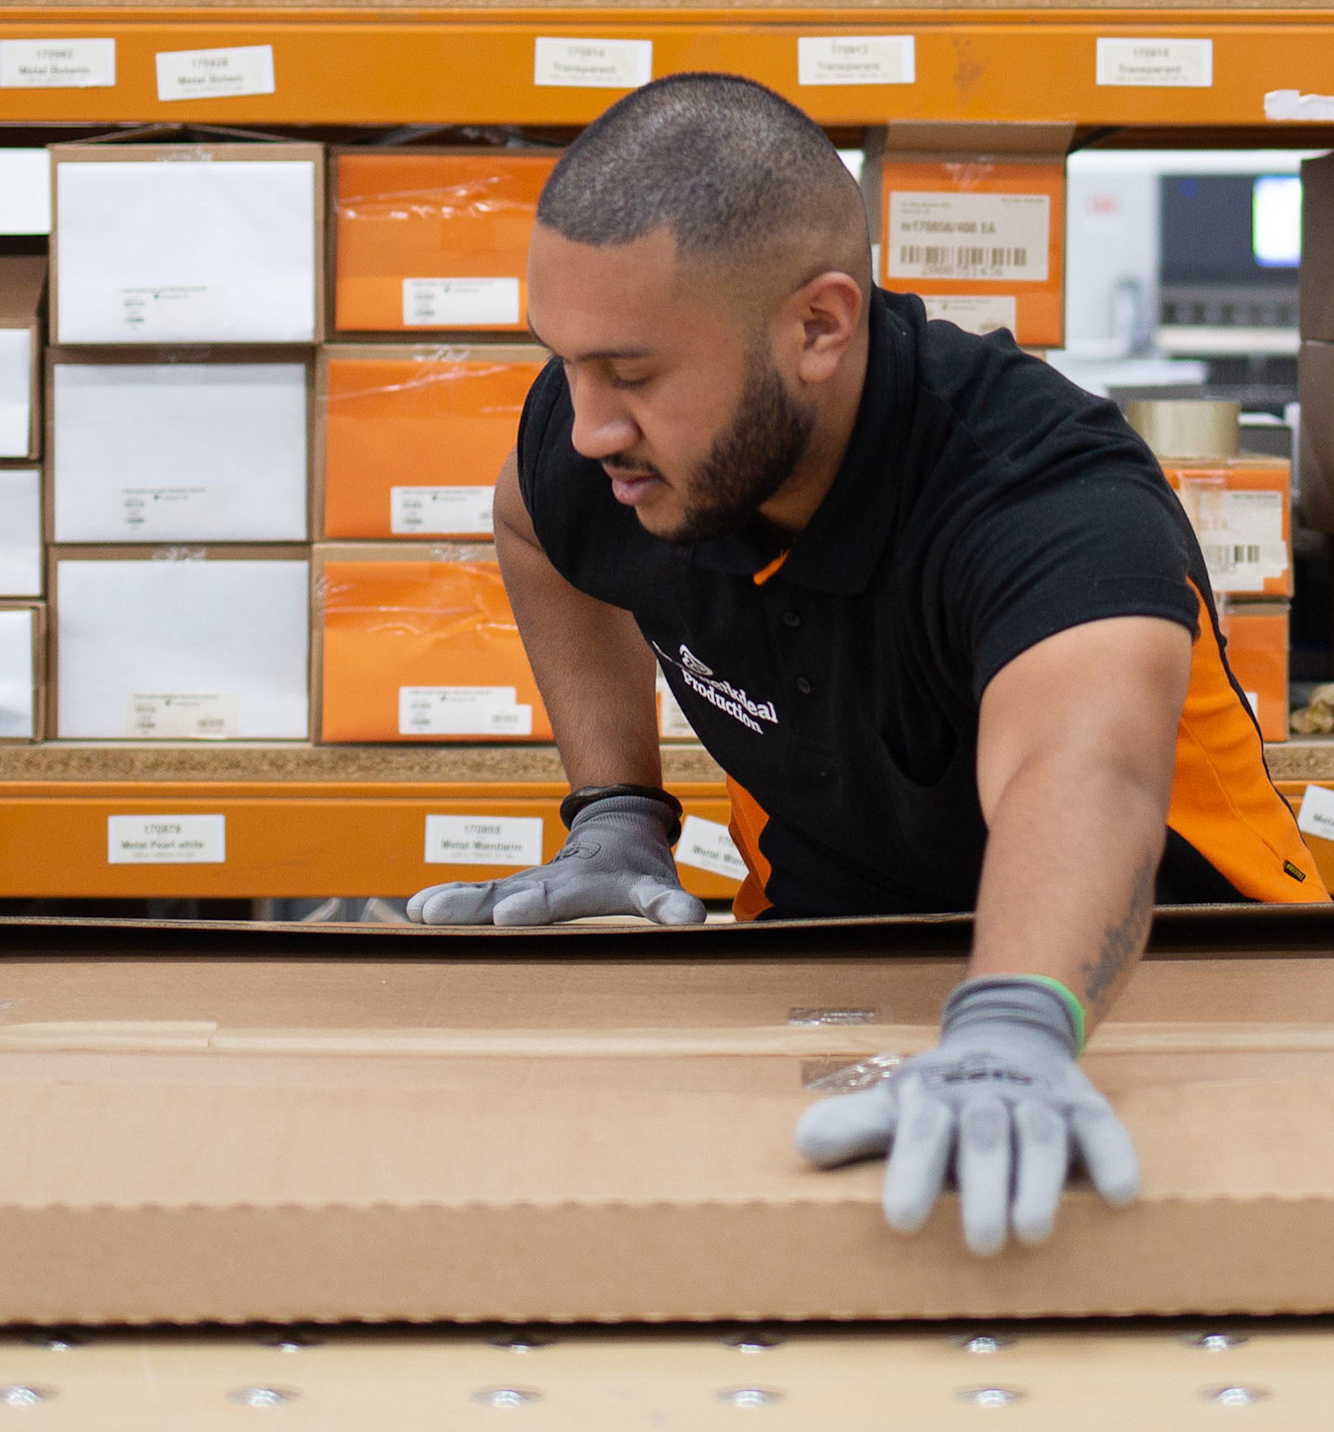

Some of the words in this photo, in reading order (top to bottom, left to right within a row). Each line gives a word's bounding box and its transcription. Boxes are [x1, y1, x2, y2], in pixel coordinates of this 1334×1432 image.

[18, 65, 48, 75] Metal
[177, 75, 206, 85] Metal
[681, 667, 764, 735] Production
[121, 840, 147, 850] Metal
[441, 839, 469, 850] Metal
